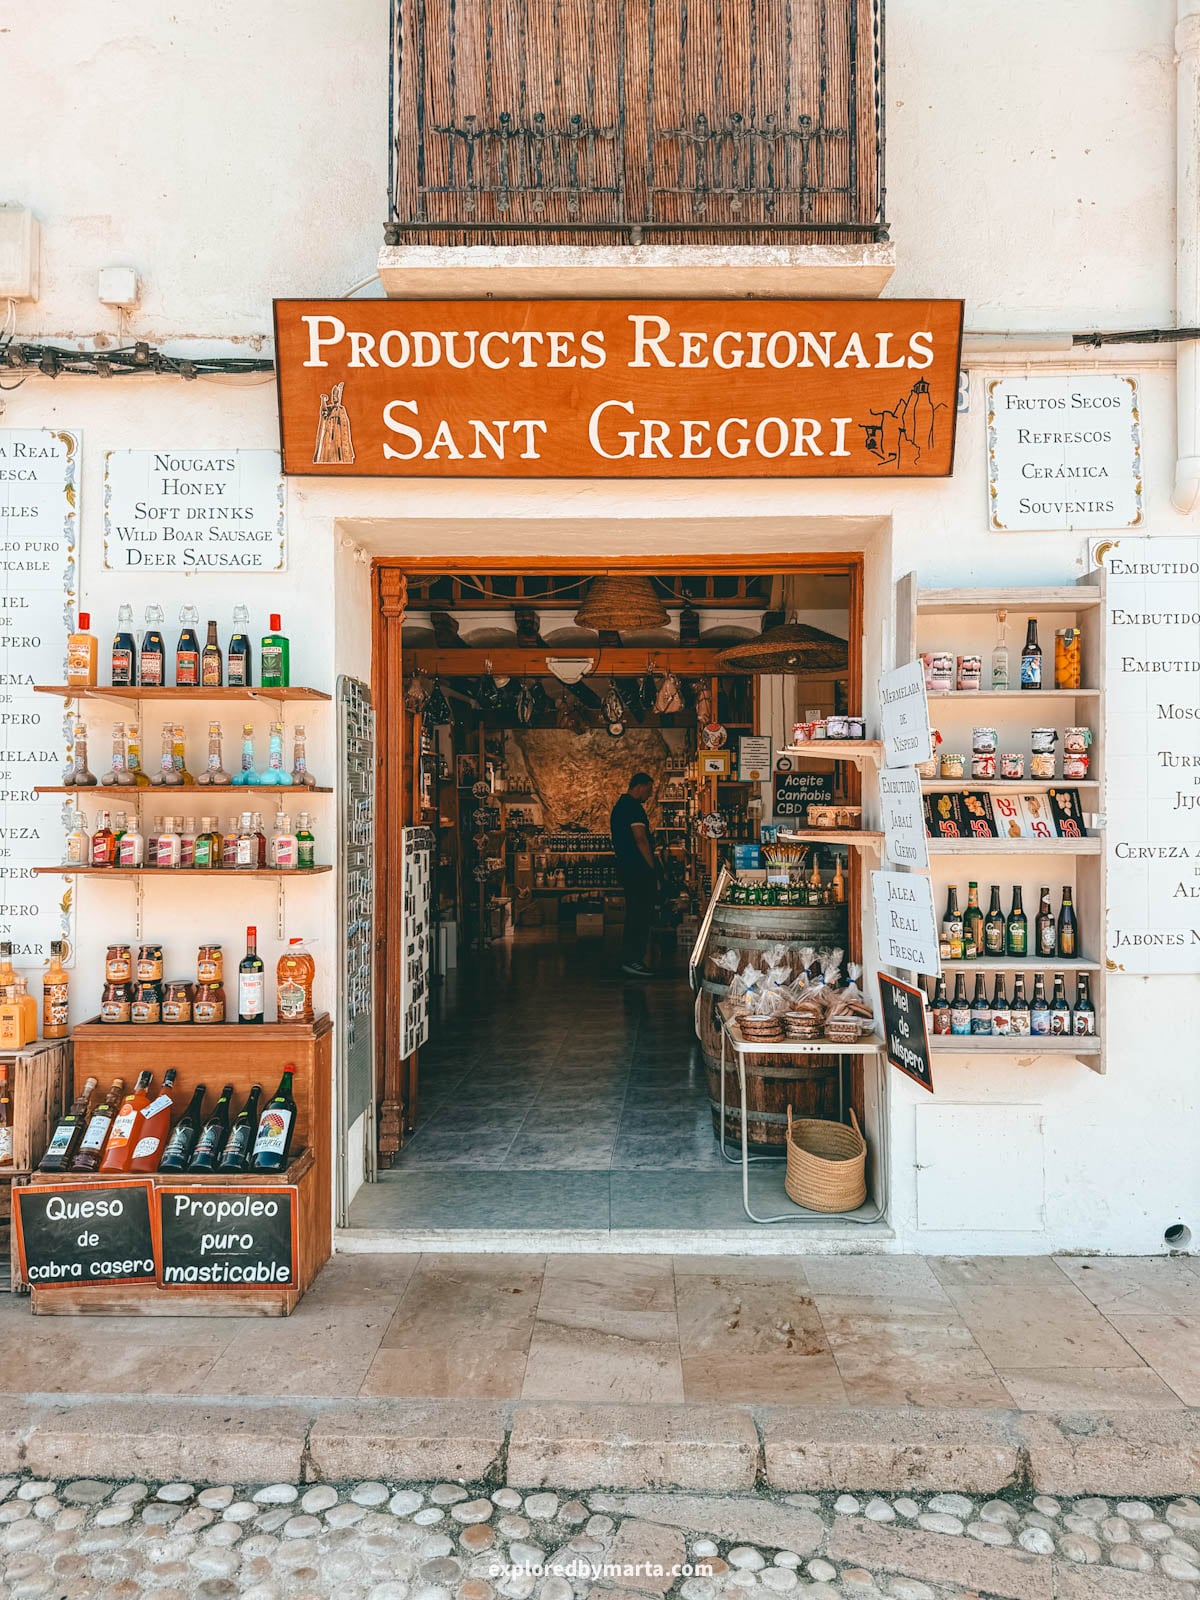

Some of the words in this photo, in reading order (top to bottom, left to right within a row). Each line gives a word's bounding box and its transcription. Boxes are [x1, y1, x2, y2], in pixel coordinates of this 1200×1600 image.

[301, 315, 607, 370] PRODUCTES
[627, 314, 935, 370] REGIONALS
[1005, 394, 1066, 410] FRUTOS
[1071, 393, 1121, 409] SECOS
[382, 399, 548, 461] SANT
[588, 399, 853, 460] GREGORI
[1017, 428, 1112, 444] REFRESCOS
[13, 442, 60, 458] REAL
[153, 454, 236, 472] NOUGATS
[1021, 462, 1109, 479] CERÁMICA
[161, 478, 227, 496] HONEY
[1, 506, 39, 518] ELES
[134, 502, 181, 520] SOFT
[186, 506, 254, 520] DRINKS
[1019, 498, 1114, 514] SOUVENIRS
[116, 526, 158, 542] WILD
[162, 526, 204, 542] BOAR
[207, 526, 273, 542] SAUSAGE
[25, 541, 60, 552] PURO
[125, 548, 177, 567] DEER
[183, 548, 262, 567] SAUSAGE
[1109, 559, 1200, 575] EMBUTIDO
[1111, 609, 1200, 625] EMBUTIDO
[1, 636, 41, 648] PERO
[882, 682, 921, 705] MERMELADA
[1, 713, 41, 725] PERO
[899, 713, 908, 726] DE
[785, 774, 824, 788] Aceite
[881, 776, 917, 795] EMBUTIDO
[1, 789, 40, 802] PERO
[776, 789, 832, 801] Cannabis
[776, 802, 803, 815] CBD
[1114, 842, 1190, 859] CERVEZA
[887, 881, 917, 902] JALEA
[0, 904, 39, 916] PERO
[890, 910, 919, 932] REAL
[1112, 930, 1185, 949] JABONES
[889, 938, 925, 965] FRESCA
[891, 985, 910, 1014] Miel
[898, 1016, 910, 1039] de
[45, 1196, 124, 1221] Queso
[174, 1195, 279, 1222] Propoleo
[77, 1230, 100, 1247] de
[200, 1232, 254, 1255] puro
[28, 1258, 82, 1279] cabra
[89, 1258, 154, 1277] casero
[164, 1261, 291, 1283] masticable
